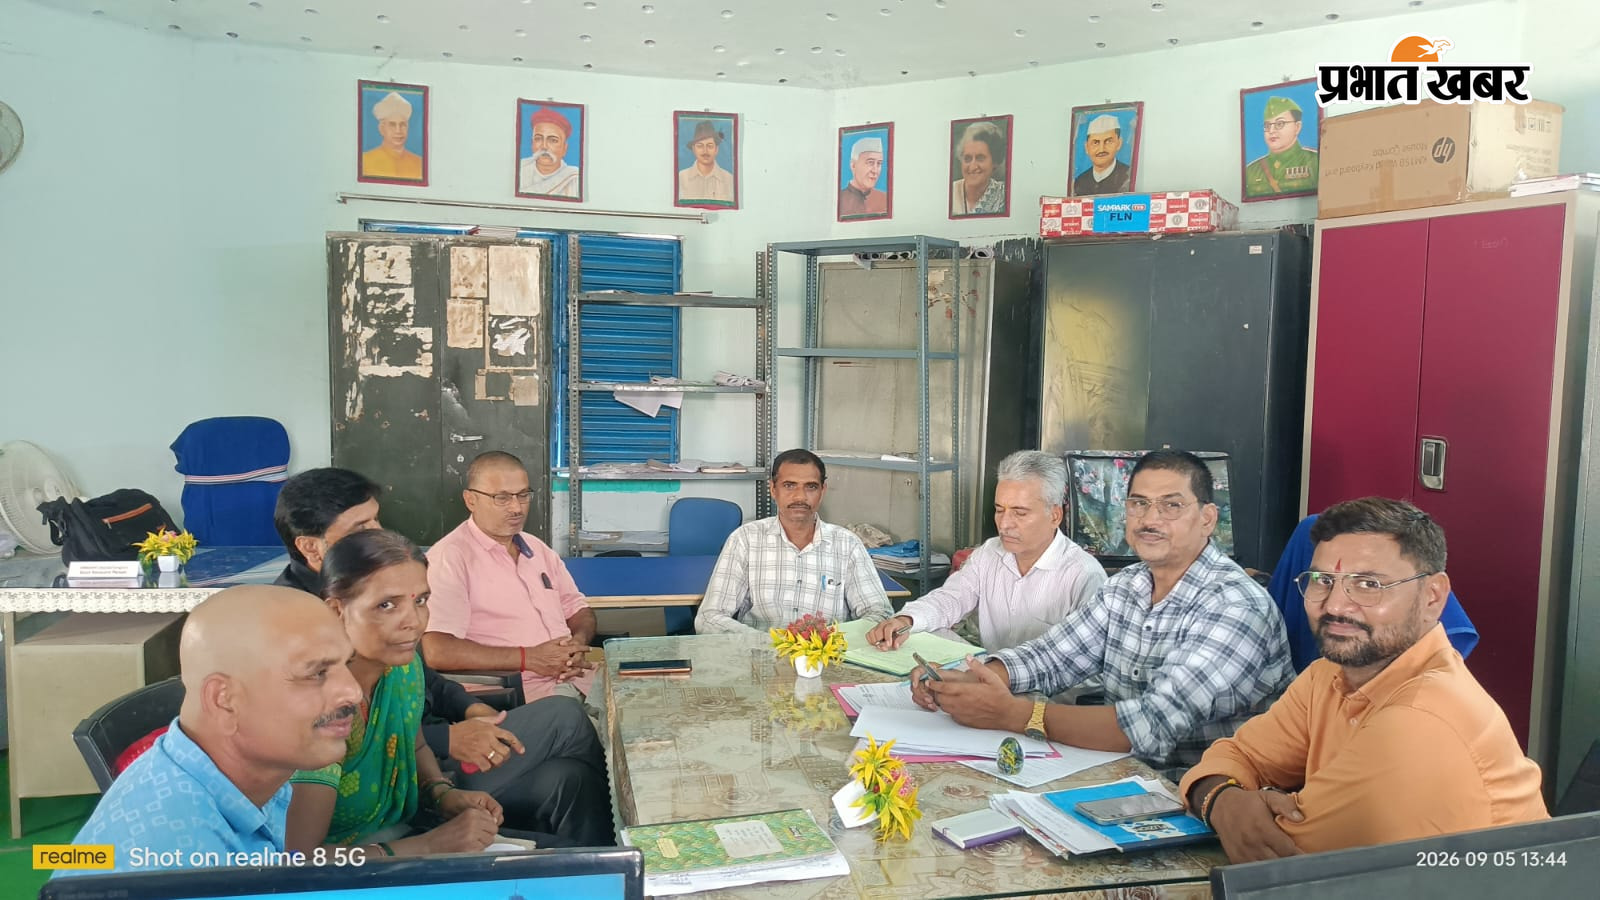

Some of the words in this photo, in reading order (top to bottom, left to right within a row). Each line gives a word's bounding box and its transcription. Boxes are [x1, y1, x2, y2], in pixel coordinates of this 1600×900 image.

[1432, 137, 1455, 164] hp
[1098, 203, 1131, 212] SAMPARK
[1110, 212, 1132, 221] FLN
